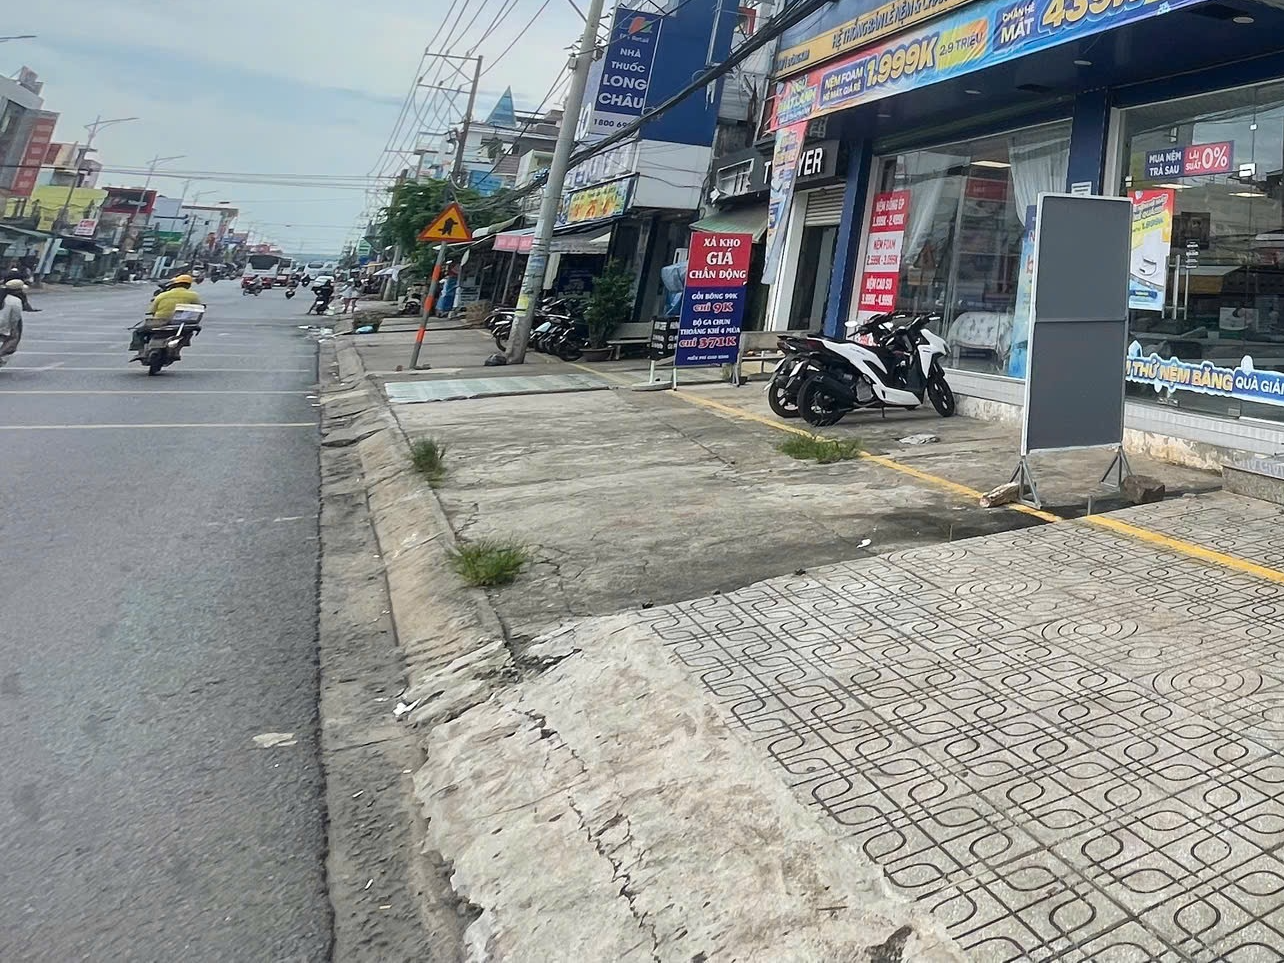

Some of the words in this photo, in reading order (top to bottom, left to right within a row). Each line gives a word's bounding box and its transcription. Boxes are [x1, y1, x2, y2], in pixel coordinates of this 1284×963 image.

[832, 32, 843, 50] HỆ
[843, 18, 868, 45] THỐNG
[894, 0, 914, 26] NỆM
[1001, 17, 1035, 43] MÁT
[939, 41, 954, 57] 2.9
[955, 32, 984, 54] TRIỆU
[620, 47, 641, 58] NHÀ
[611, 61, 645, 73] THUỐC
[866, 35, 939, 87] 1.999K
[602, 74, 648, 90] LONG
[824, 74, 841, 90] NỆM
[841, 67, 864, 84] FOAM
[598, 92, 644, 109] CHÂU
[593, 118, 614, 127] 1800
[1149, 152, 1166, 164] MUA
[1166, 149, 1182, 165] NỆM
[1188, 150, 1199, 160] LÃI
[1201, 146, 1228, 170] 0%
[1149, 164, 1164, 176] TRẢ
[1164, 167, 1180, 175] SAU
[1185, 160, 1201, 171] SUẤT
[703, 236, 717, 247] XẢ
[719, 238, 741, 247] KHO
[706, 248, 734, 265] GIÁ
[689, 266, 716, 279] CHẤN
[719, 269, 747, 280] ĐỘNG
[876, 278, 886, 290] CAO
[712, 302, 734, 313] 9K
[692, 318, 702, 327] BỘ
[680, 327, 706, 335] THOÁNG
[707, 327, 720, 335] KHÍ
[1159, 364, 1191, 388] NỆM
[1191, 367, 1233, 392] BĂNG
[1235, 373, 1259, 391] QUÀ
[1260, 377, 1284, 395] GIẢI
